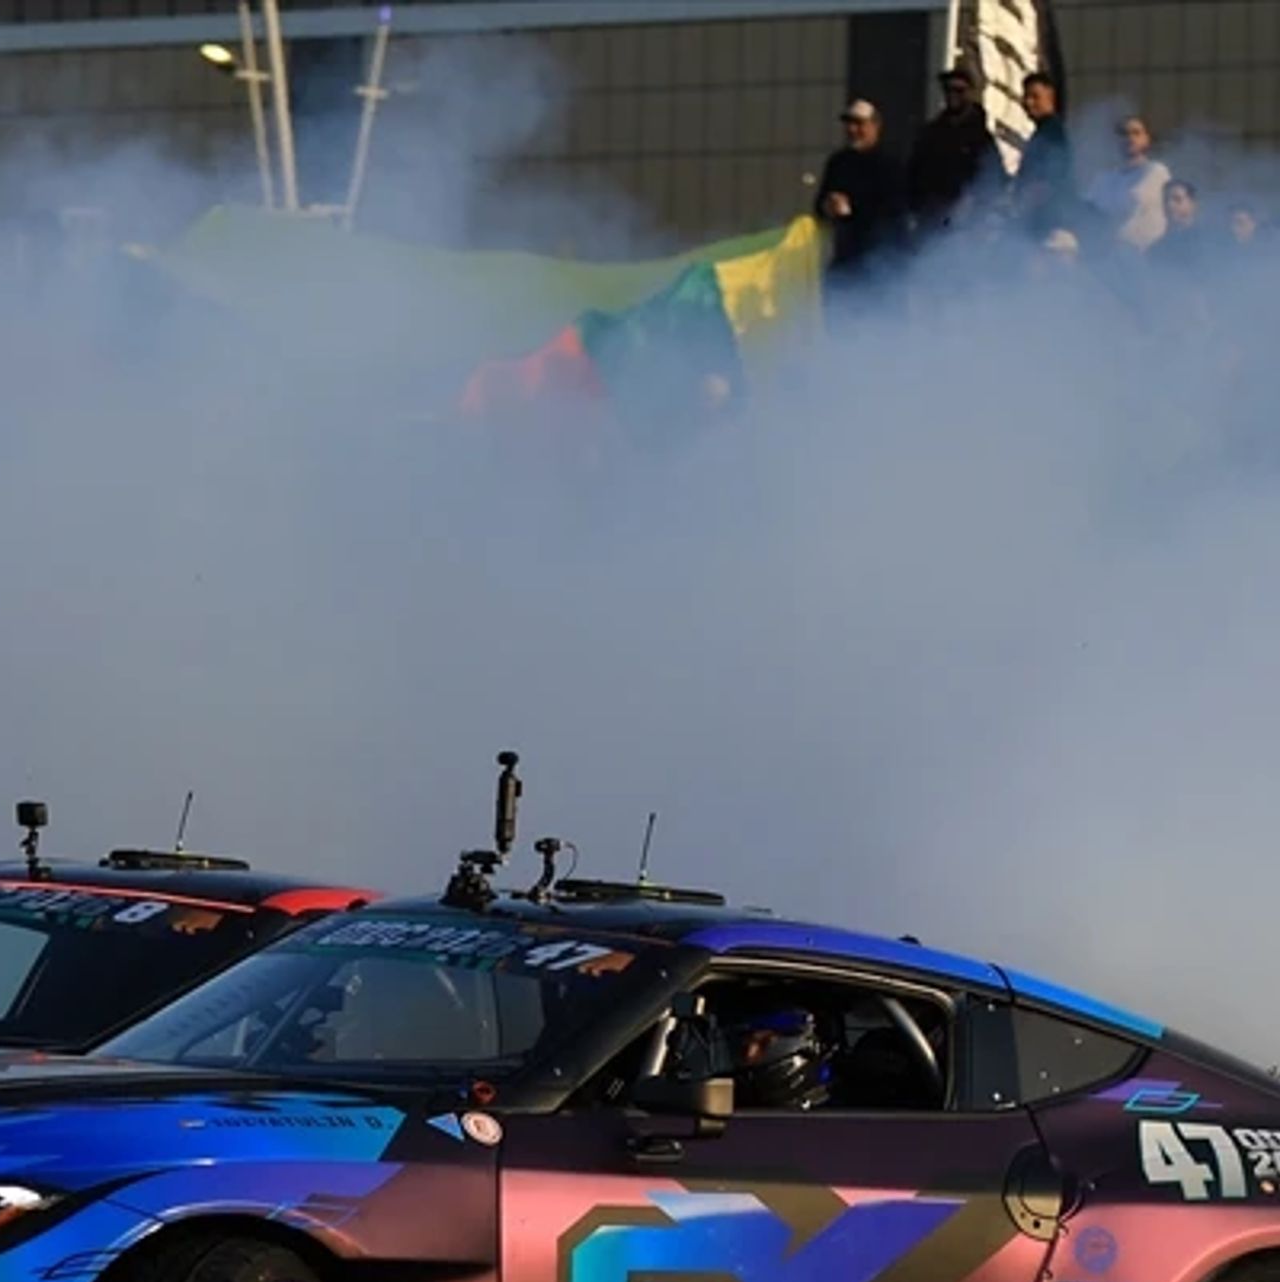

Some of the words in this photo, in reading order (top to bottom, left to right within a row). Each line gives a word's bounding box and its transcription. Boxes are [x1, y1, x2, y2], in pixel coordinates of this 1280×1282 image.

[113, 900, 169, 923] 8
[524, 941, 612, 971] 47
[1139, 1119, 1248, 1200] 47
